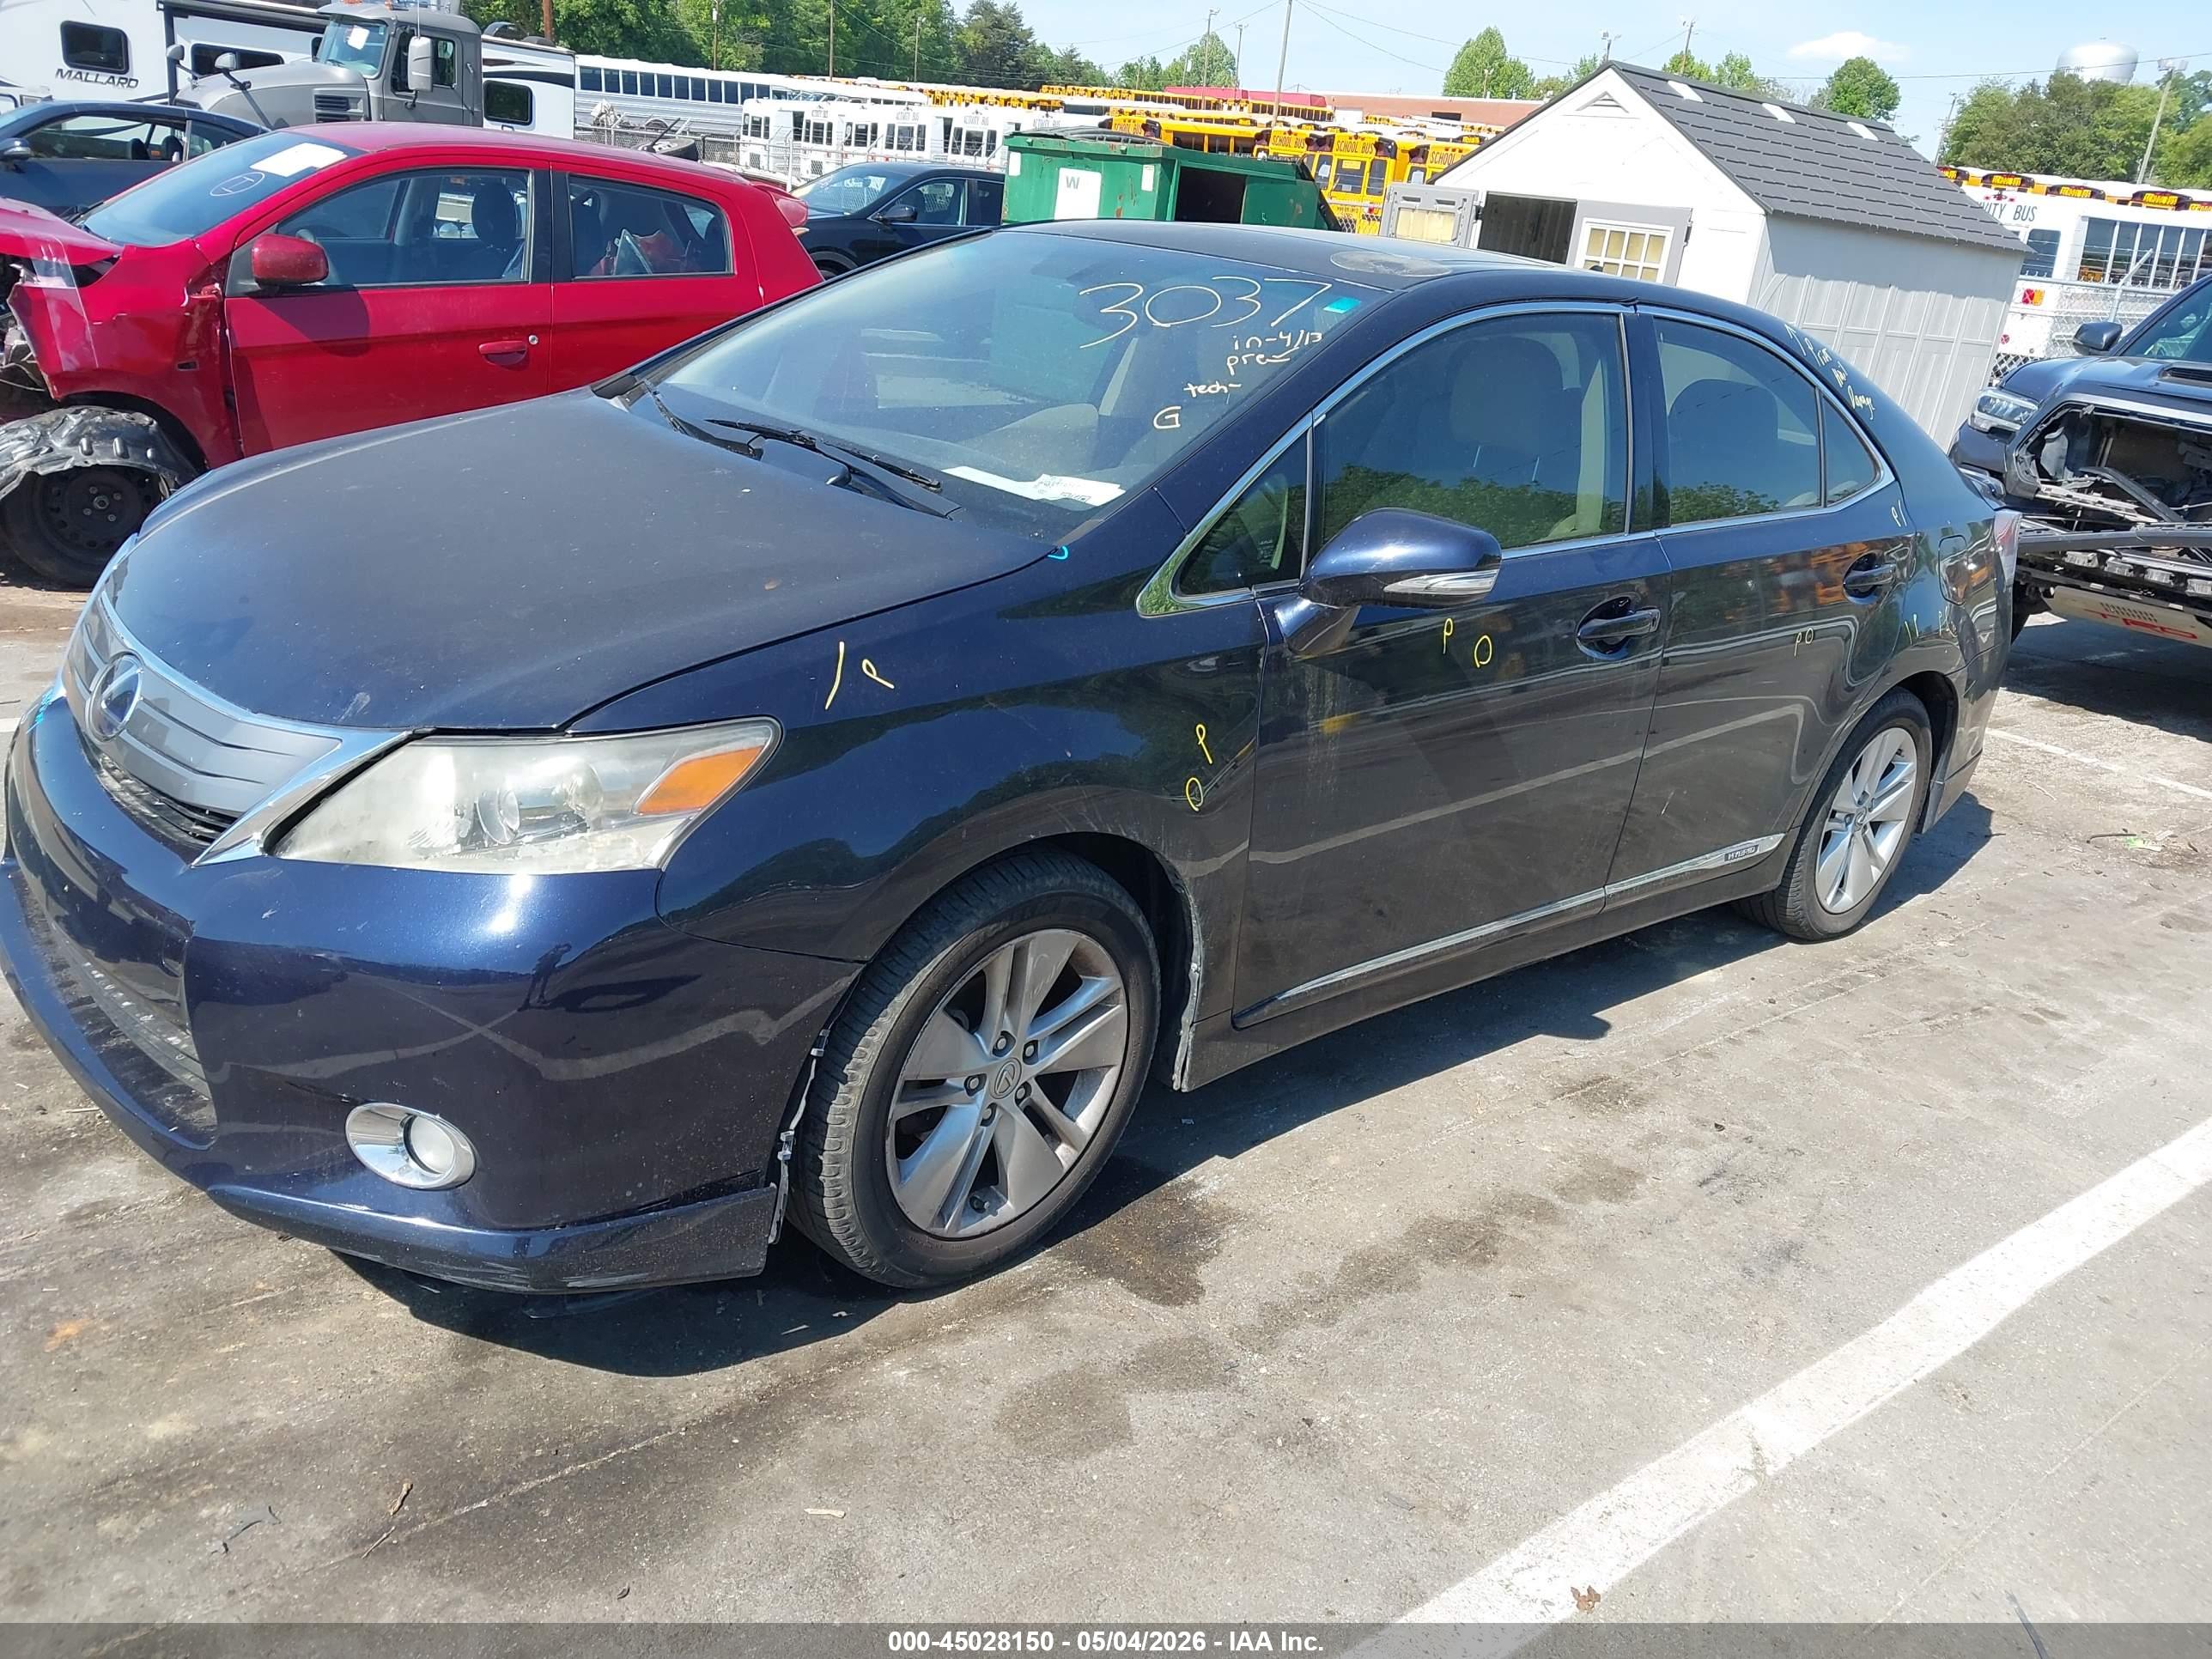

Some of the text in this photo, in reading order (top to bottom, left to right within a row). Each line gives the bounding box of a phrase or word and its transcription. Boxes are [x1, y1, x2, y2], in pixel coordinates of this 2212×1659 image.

[55, 68, 139, 88] MALLARD
[1272, 135, 1306, 149] SCHOOL BUS
[1336, 140, 1374, 155] SCHOOL BUS
[1431, 150, 1456, 166] SCHOOL
[2013, 204, 2038, 222] BUS
[1079, 276, 1334, 349] 3037
[1152, 405, 1182, 428] G
[1727, 846, 1756, 860] HYBRID
